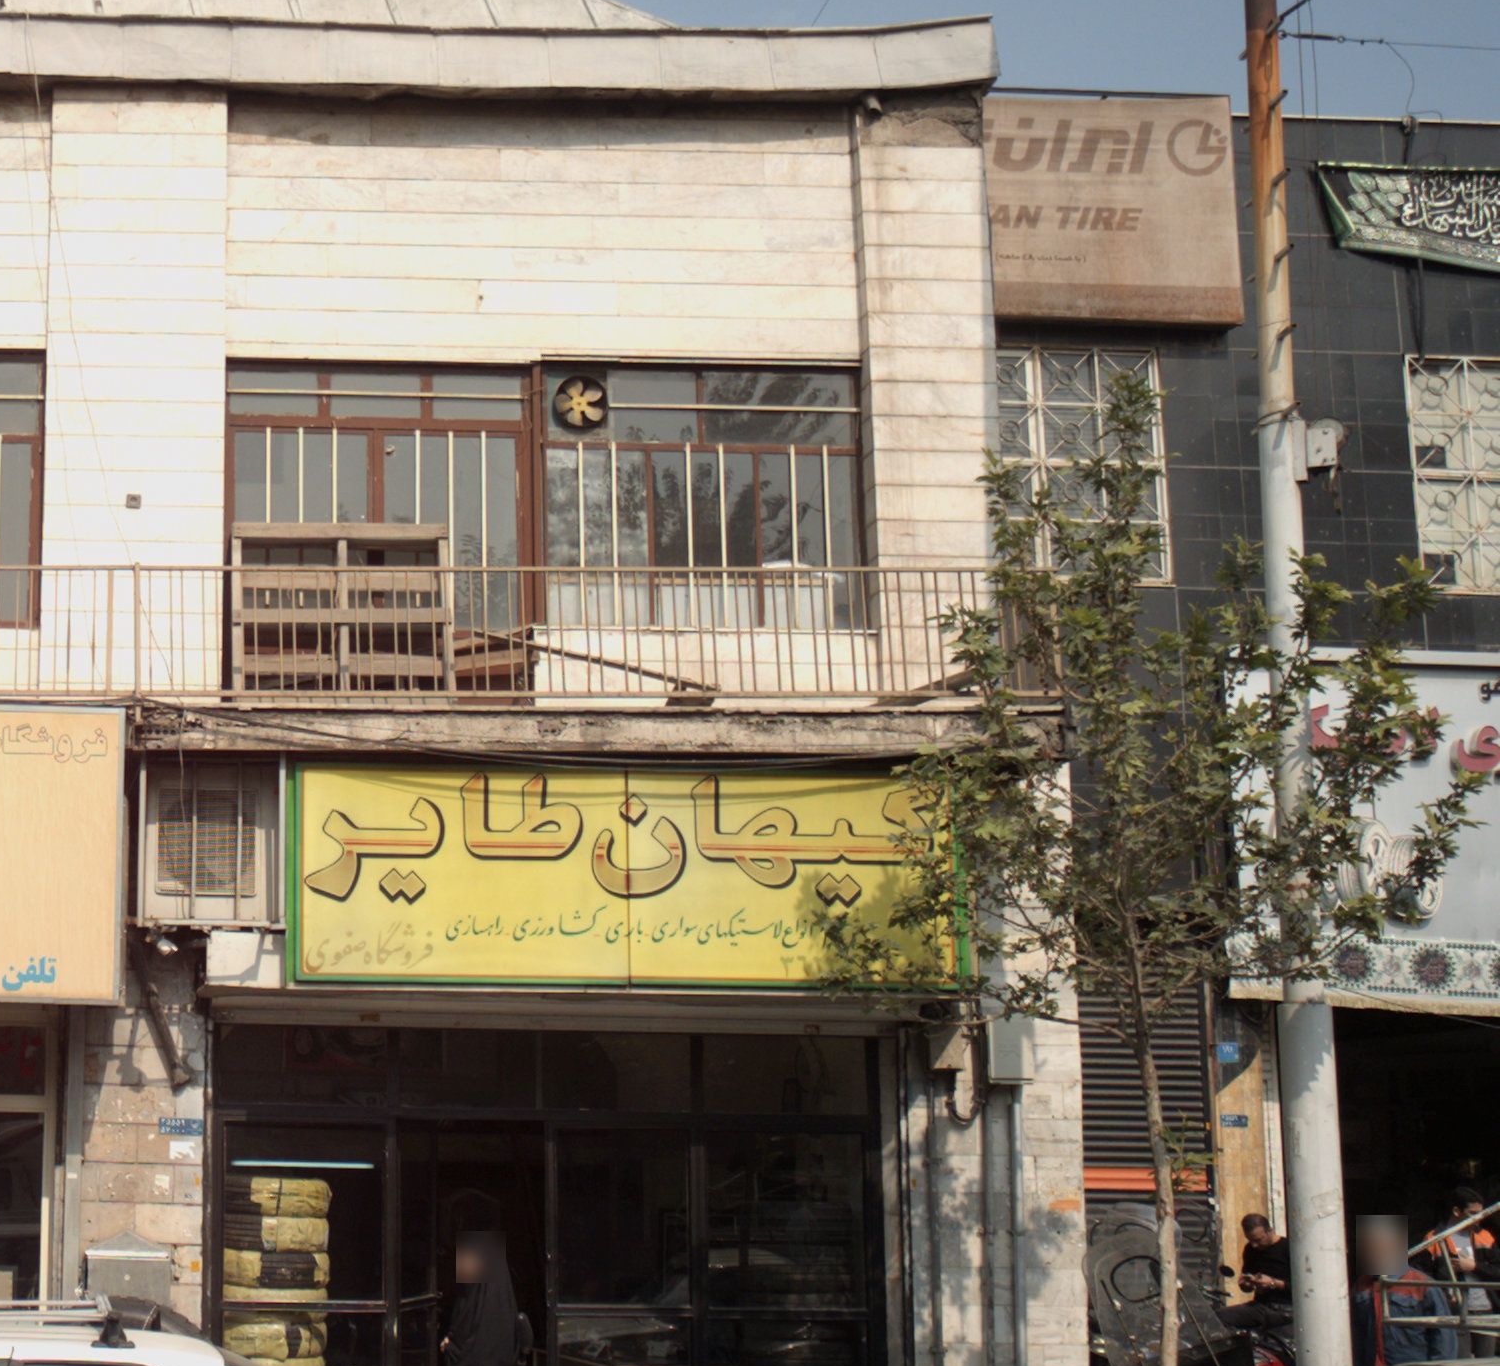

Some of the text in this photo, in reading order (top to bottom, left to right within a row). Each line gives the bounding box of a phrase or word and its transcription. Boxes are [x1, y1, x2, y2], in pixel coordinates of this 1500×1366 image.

[991, 204, 1143, 232] AN TIRE
[304, 771, 584, 905] طایر
[651, 915, 698, 943] سواری
